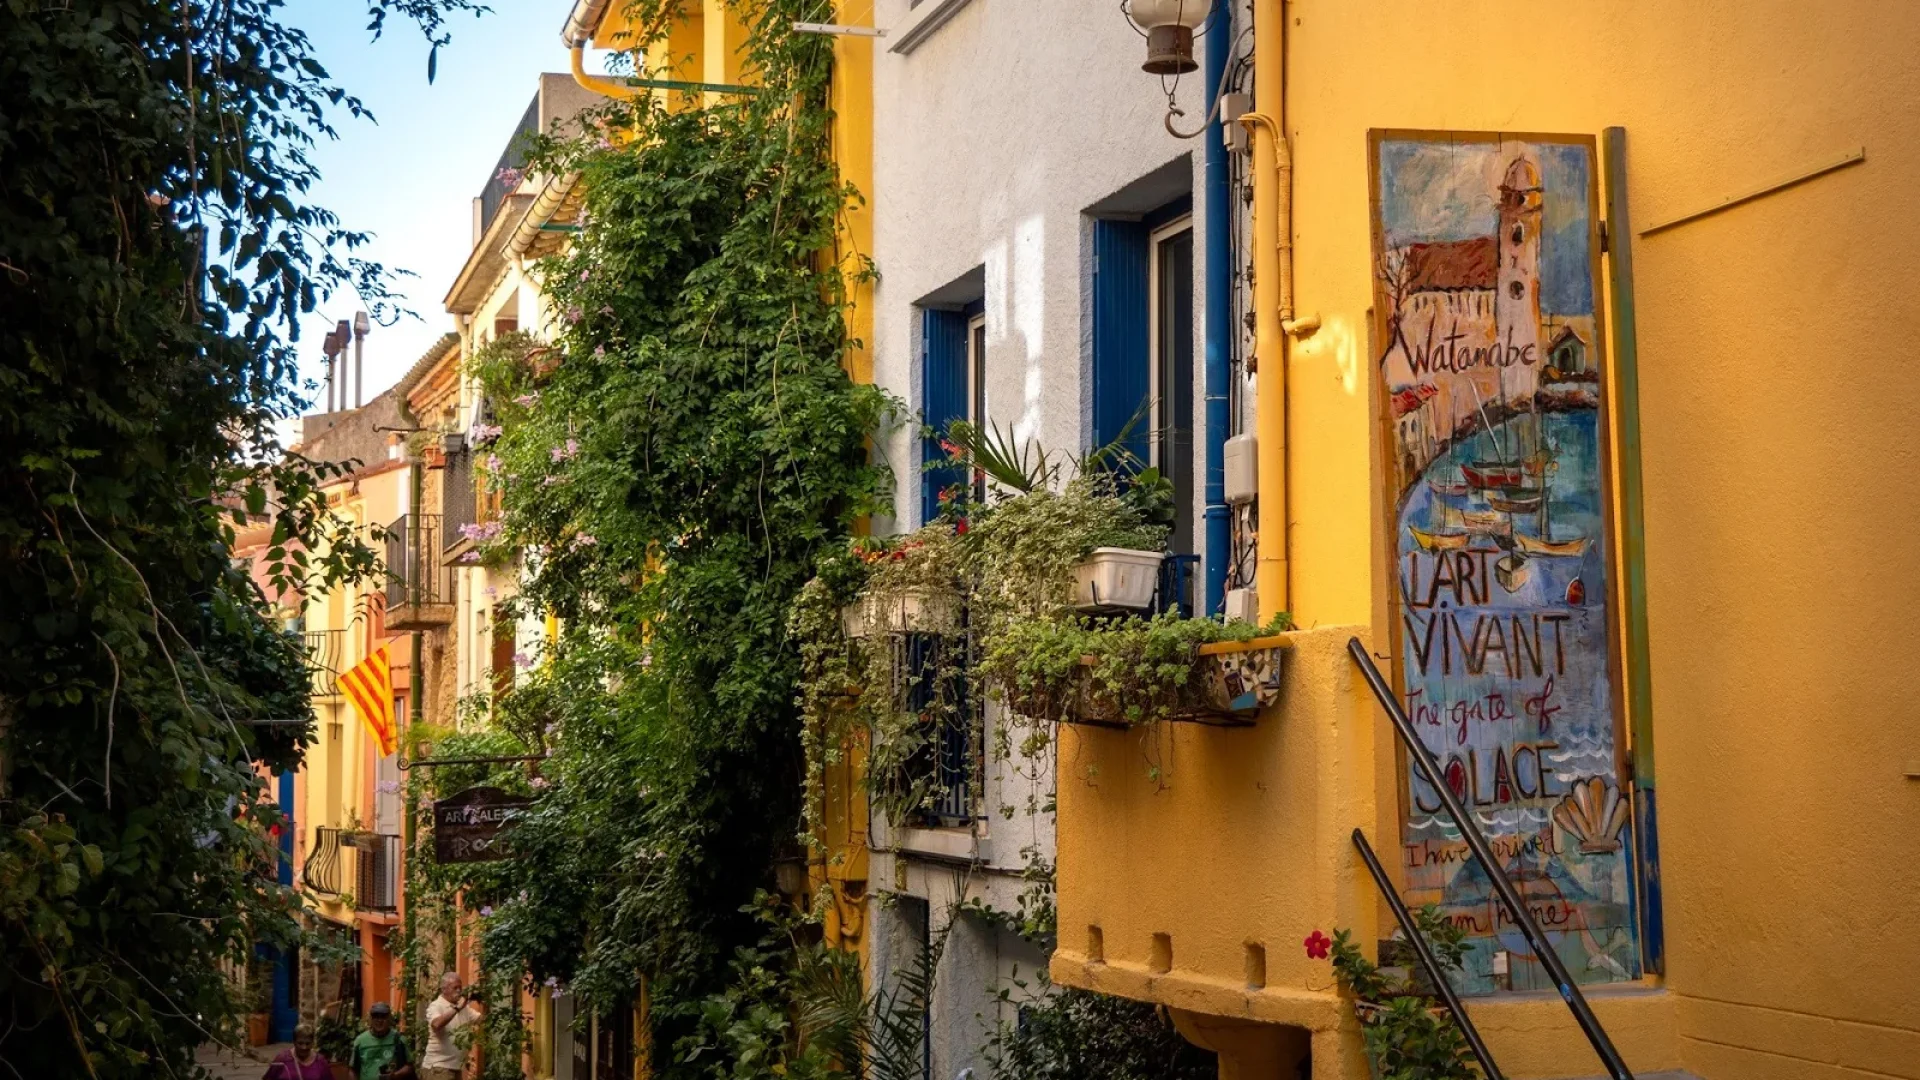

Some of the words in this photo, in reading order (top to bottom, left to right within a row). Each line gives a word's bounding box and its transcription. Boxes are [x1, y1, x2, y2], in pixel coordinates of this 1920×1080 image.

[1394, 304, 1536, 376] Watanabe
[1405, 688, 1441, 726] The
[1451, 688, 1516, 745] gate
[1524, 673, 1562, 735] of
[1413, 742, 1562, 814] SOLACE
[1406, 845, 1421, 867] I
[1425, 839, 1470, 865] have
[1491, 824, 1566, 857] rrived
[1495, 899, 1570, 930] hme
